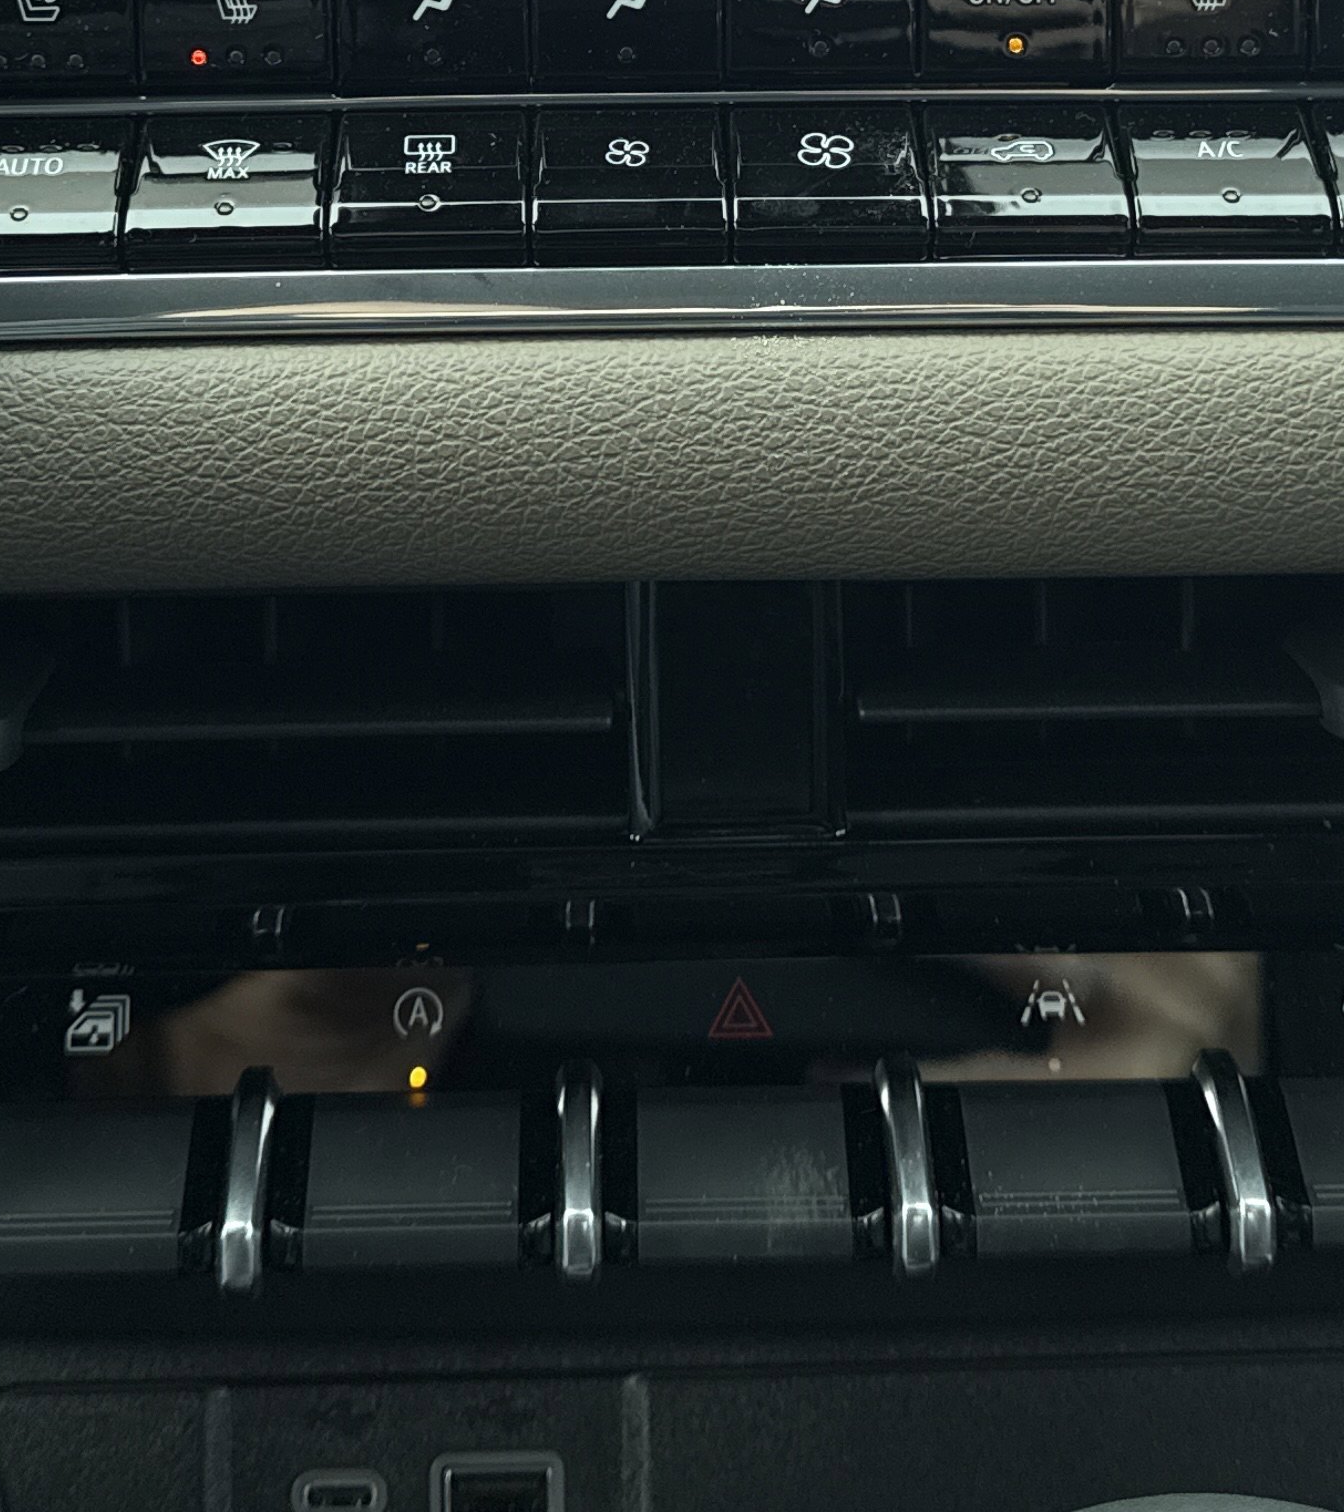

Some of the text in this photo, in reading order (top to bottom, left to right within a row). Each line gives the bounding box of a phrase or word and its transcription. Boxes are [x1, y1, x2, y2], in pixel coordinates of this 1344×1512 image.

[1197, 141, 1243, 158] A/C
[207, 167, 249, 180] MAX
[405, 162, 452, 174] REAR
